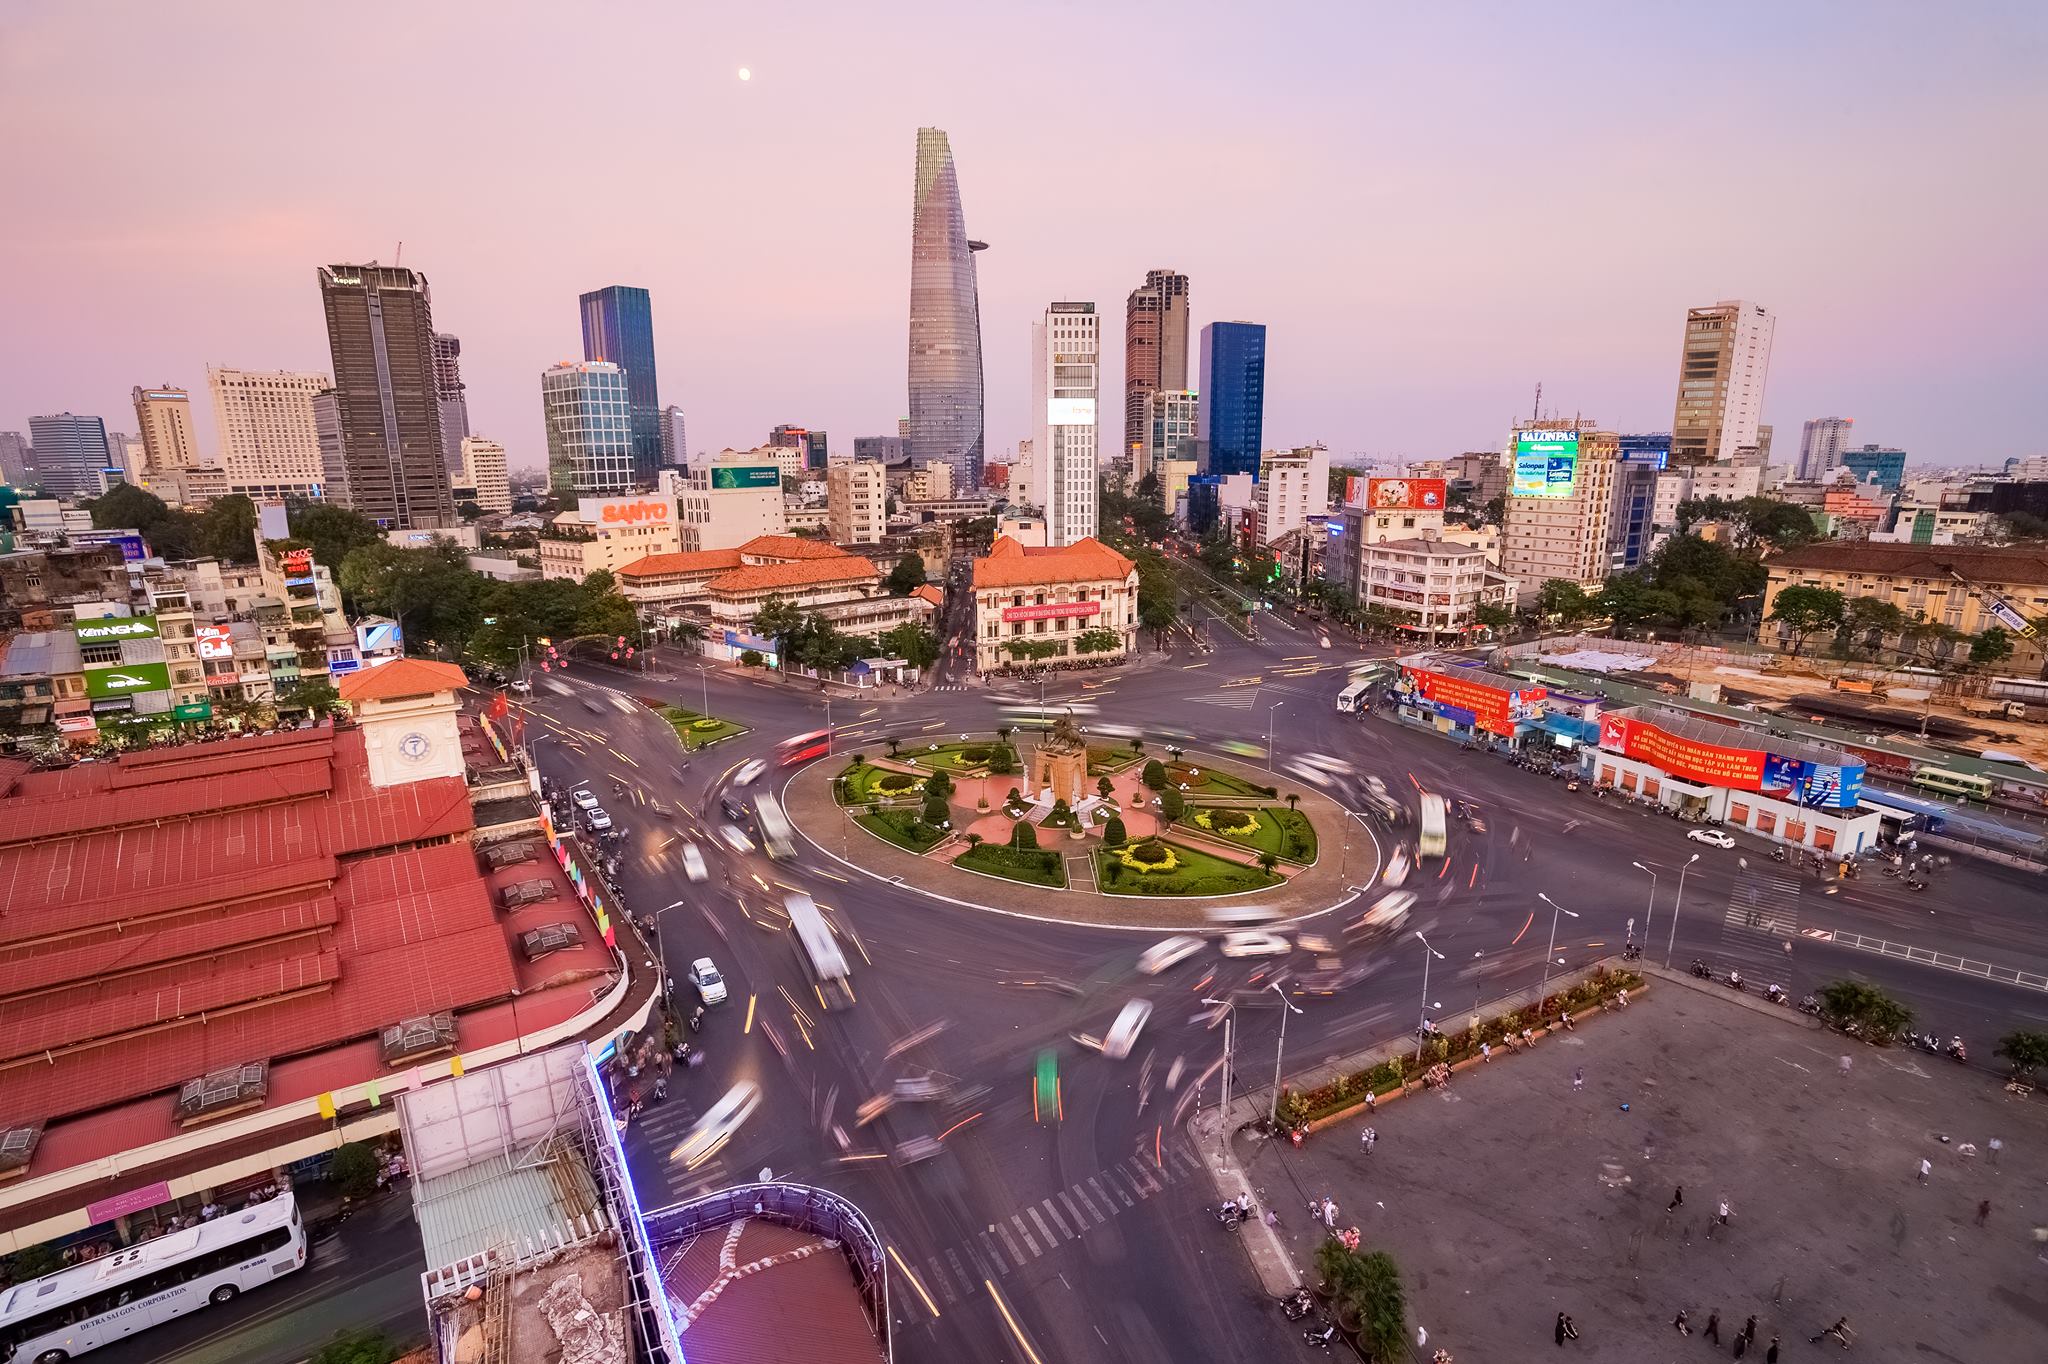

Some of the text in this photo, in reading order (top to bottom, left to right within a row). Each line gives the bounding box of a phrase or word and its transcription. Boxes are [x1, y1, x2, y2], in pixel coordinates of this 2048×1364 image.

[602, 501, 668, 524] SANYO
[80, 1318, 106, 1331] DETRA
[137, 1287, 187, 1310] CORPORATION
